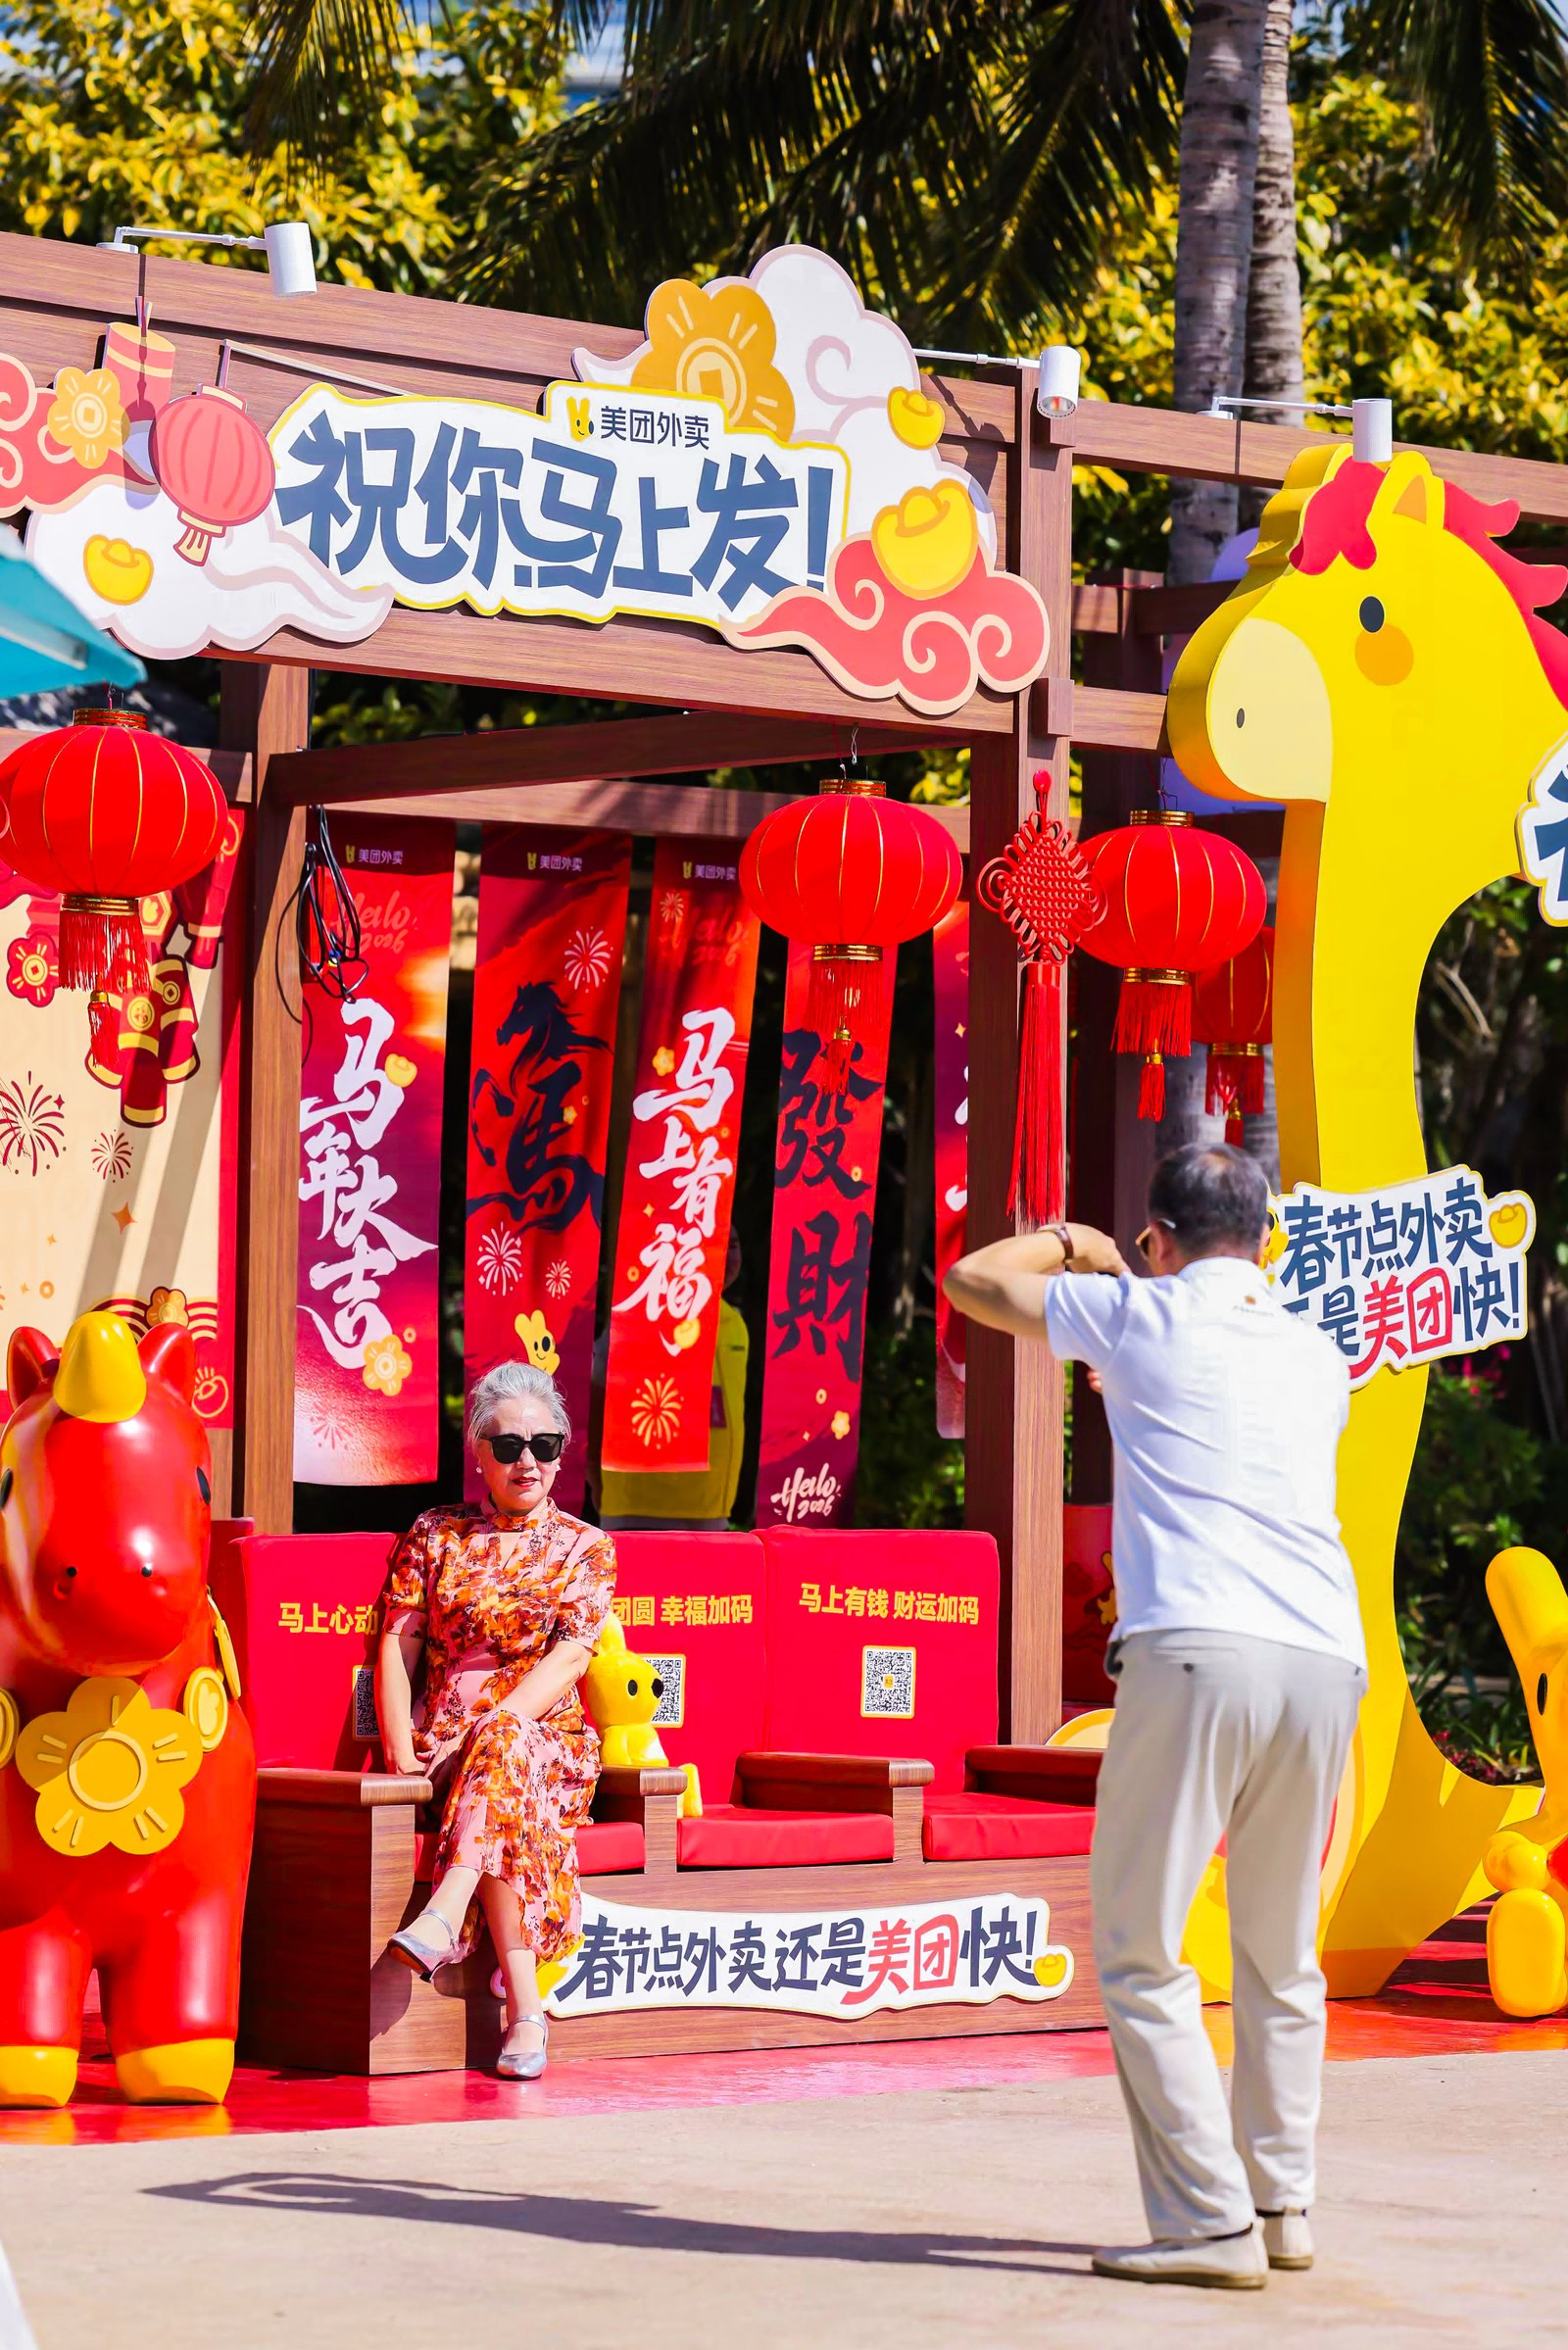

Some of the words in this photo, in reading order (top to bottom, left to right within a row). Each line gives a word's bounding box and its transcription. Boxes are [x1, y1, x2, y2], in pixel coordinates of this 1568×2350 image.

[600, 405, 710, 451] 美团外卖
[275, 409, 834, 612] 祝你马上发!
[358, 848, 404, 865] 美团外卖
[539, 853, 583, 872] 美团外卖
[694, 864, 737, 881] 美团外卖
[296, 997, 439, 1369] 马年大吉
[612, 1006, 739, 1357] 马上有福
[1279, 1176, 1494, 1296] 春节点外卖
[278, 1602, 378, 1636] 马上心动
[612, 1596, 656, 1627] 团圆
[661, 1594, 754, 1627] 幸福加码
[799, 1583, 889, 1619] 马上有钱
[893, 1591, 980, 1625] 财运加码
[554, 1905, 1044, 2006] 春节点外卖还是美团快!
